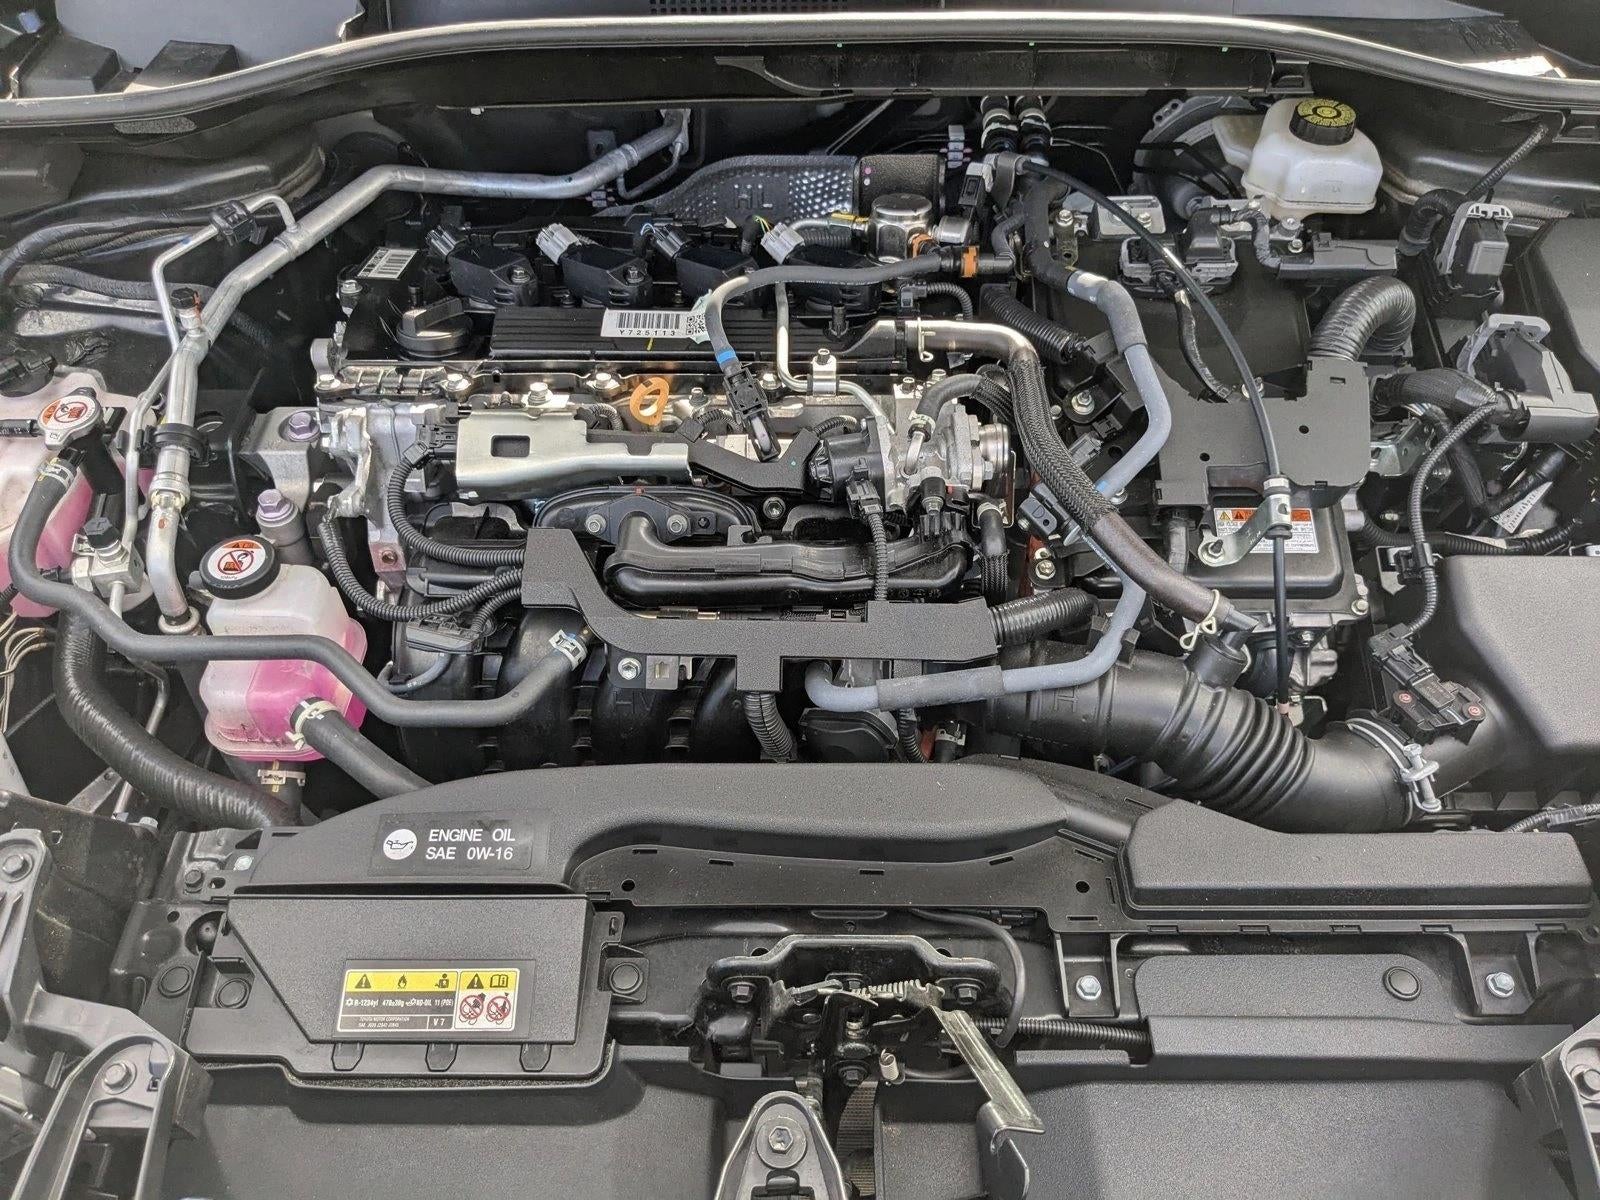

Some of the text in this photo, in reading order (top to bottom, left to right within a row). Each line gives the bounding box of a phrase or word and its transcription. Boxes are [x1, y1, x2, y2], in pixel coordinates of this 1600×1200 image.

[428, 828, 516, 842] ENGINE OIL
[425, 846, 514, 860] SAE 0W-16
[433, 1018, 445, 1026] V 7
